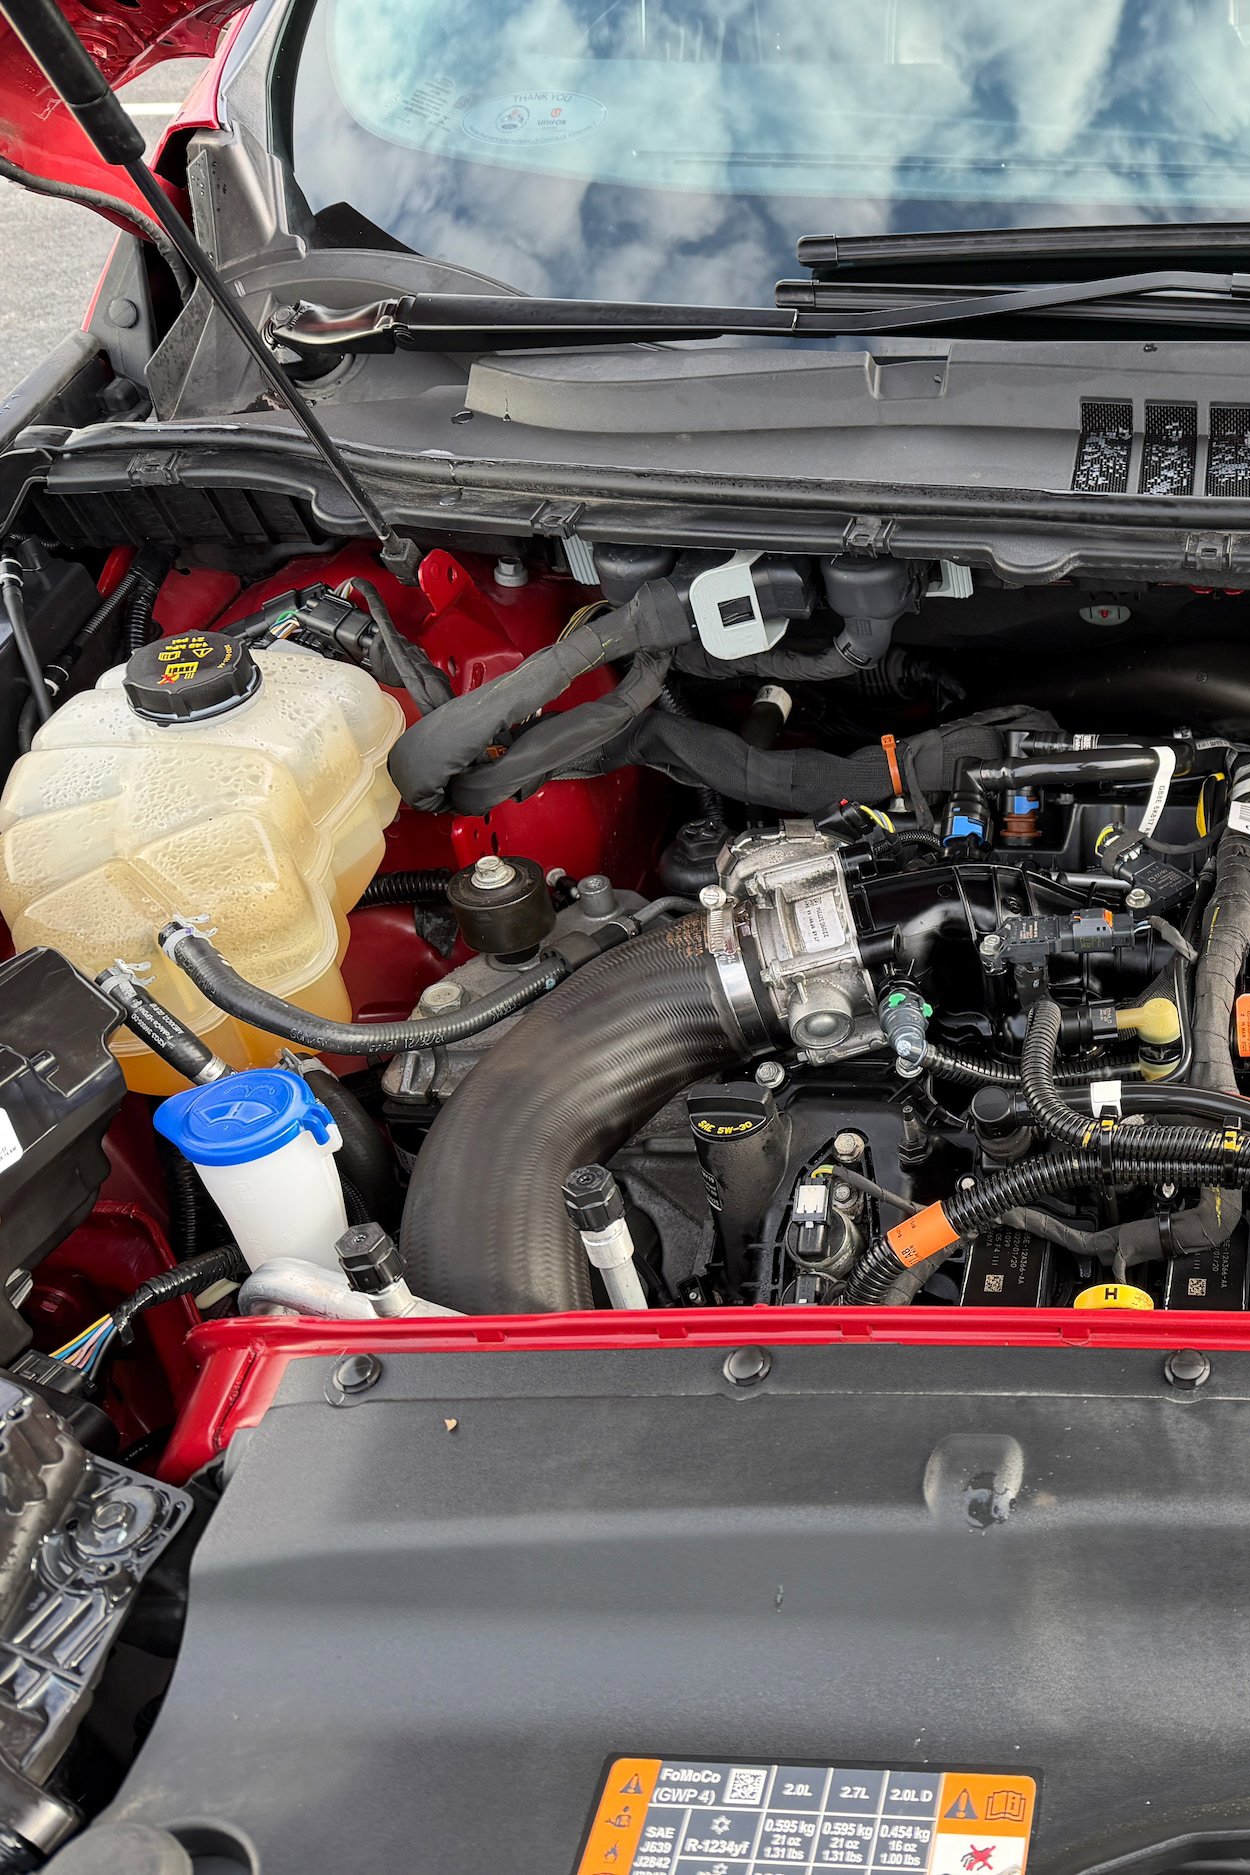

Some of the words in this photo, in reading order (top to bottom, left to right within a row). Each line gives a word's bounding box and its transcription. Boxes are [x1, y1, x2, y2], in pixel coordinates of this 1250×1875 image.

[513, 93, 548, 103] THANK
[551, 94, 574, 103] YOU
[698, 1120, 716, 1132] SAE
[716, 1120, 753, 1134] 5W-30
[1104, 1288, 1118, 1300] H
[660, 1767, 722, 1784] FoMoCo
[652, 1787, 698, 1806] (GWP
[698, 1788, 716, 1806] 4)
[782, 1783, 812, 1798] 2.0L
[840, 1786, 870, 1800] 2.7L
[890, 1788, 919, 1802] 2.0L
[920, 1788, 933, 1802] D
[644, 1826, 675, 1839] SAE
[764, 1820, 796, 1836] 0.595
[796, 1820, 816, 1838] kg
[822, 1822, 855, 1838] 0.595
[856, 1822, 874, 1840] kg
[880, 1824, 912, 1840] 0.454
[912, 1826, 931, 1844] kg
[638, 1840, 672, 1854] J639
[685, 1838, 750, 1856] R-1234yf
[771, 1834, 787, 1848] 21
[788, 1836, 801, 1848] oz
[829, 1837, 845, 1850] 21
[846, 1838, 860, 1850] oz
[888, 1840, 904, 1852] 16
[904, 1842, 918, 1853] oz
[764, 1846, 786, 1860] 1.31
[786, 1848, 804, 1860] lbs
[822, 1850, 844, 1862] 1.31
[844, 1850, 864, 1864] lbs
[880, 1852, 902, 1866] 1.00
[902, 1854, 921, 1867] lbs
